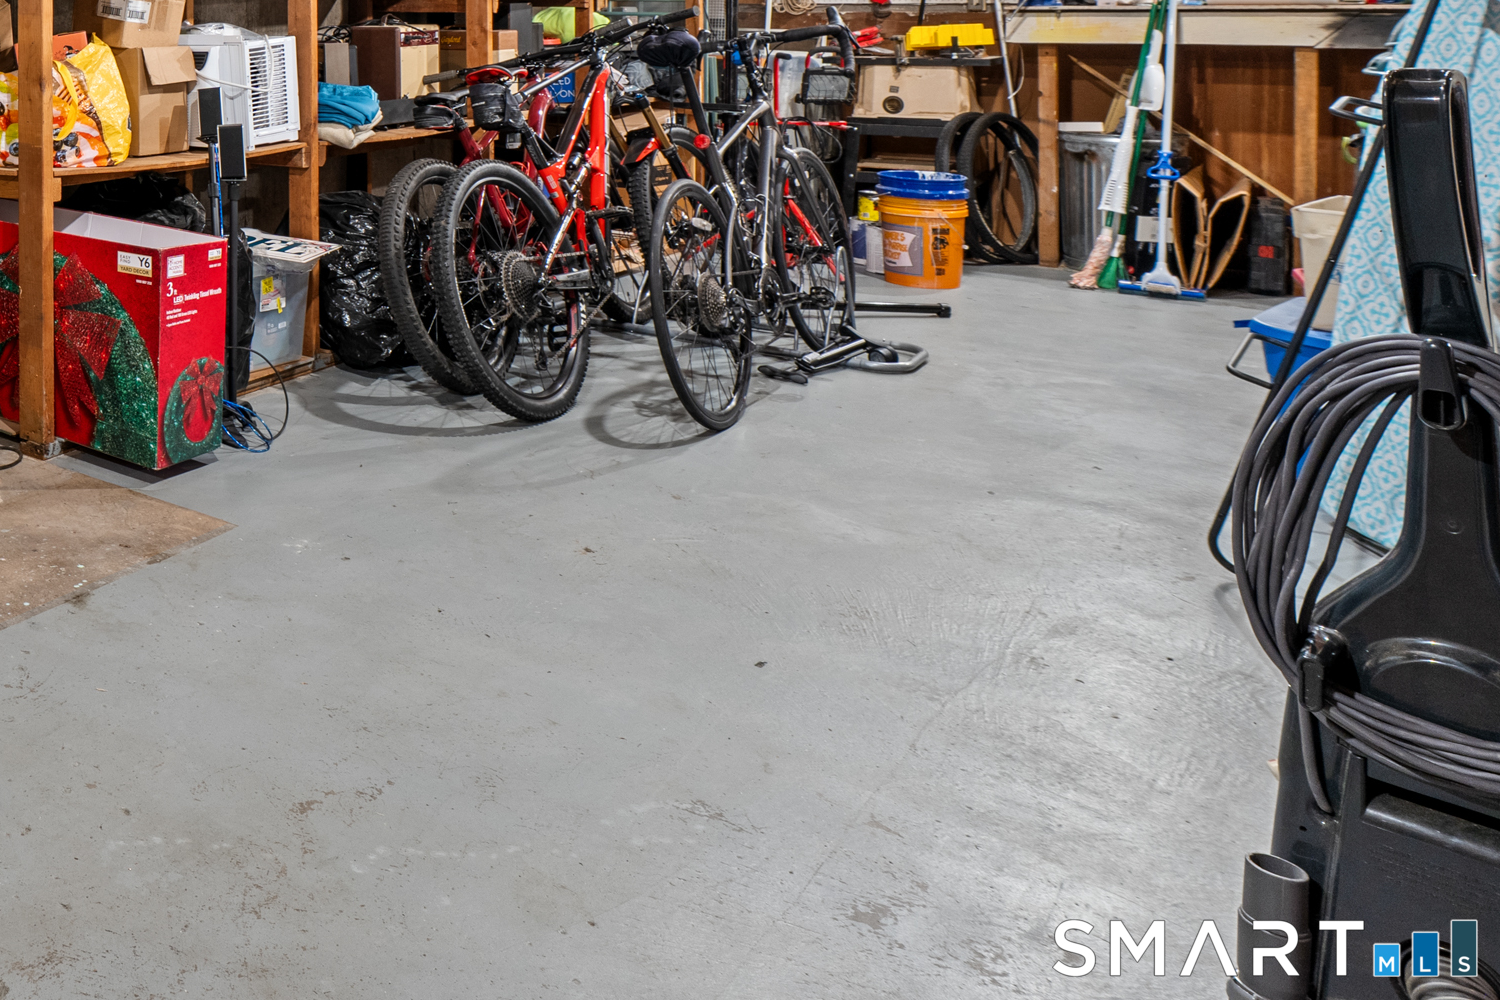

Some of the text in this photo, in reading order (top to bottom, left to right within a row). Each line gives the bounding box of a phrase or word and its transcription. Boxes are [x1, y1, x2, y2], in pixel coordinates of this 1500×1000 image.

[138, 256, 151, 269] Y6
[166, 281, 173, 297] 3
[173, 296, 183, 304] LED
[210, 287, 222, 295] Wreath
